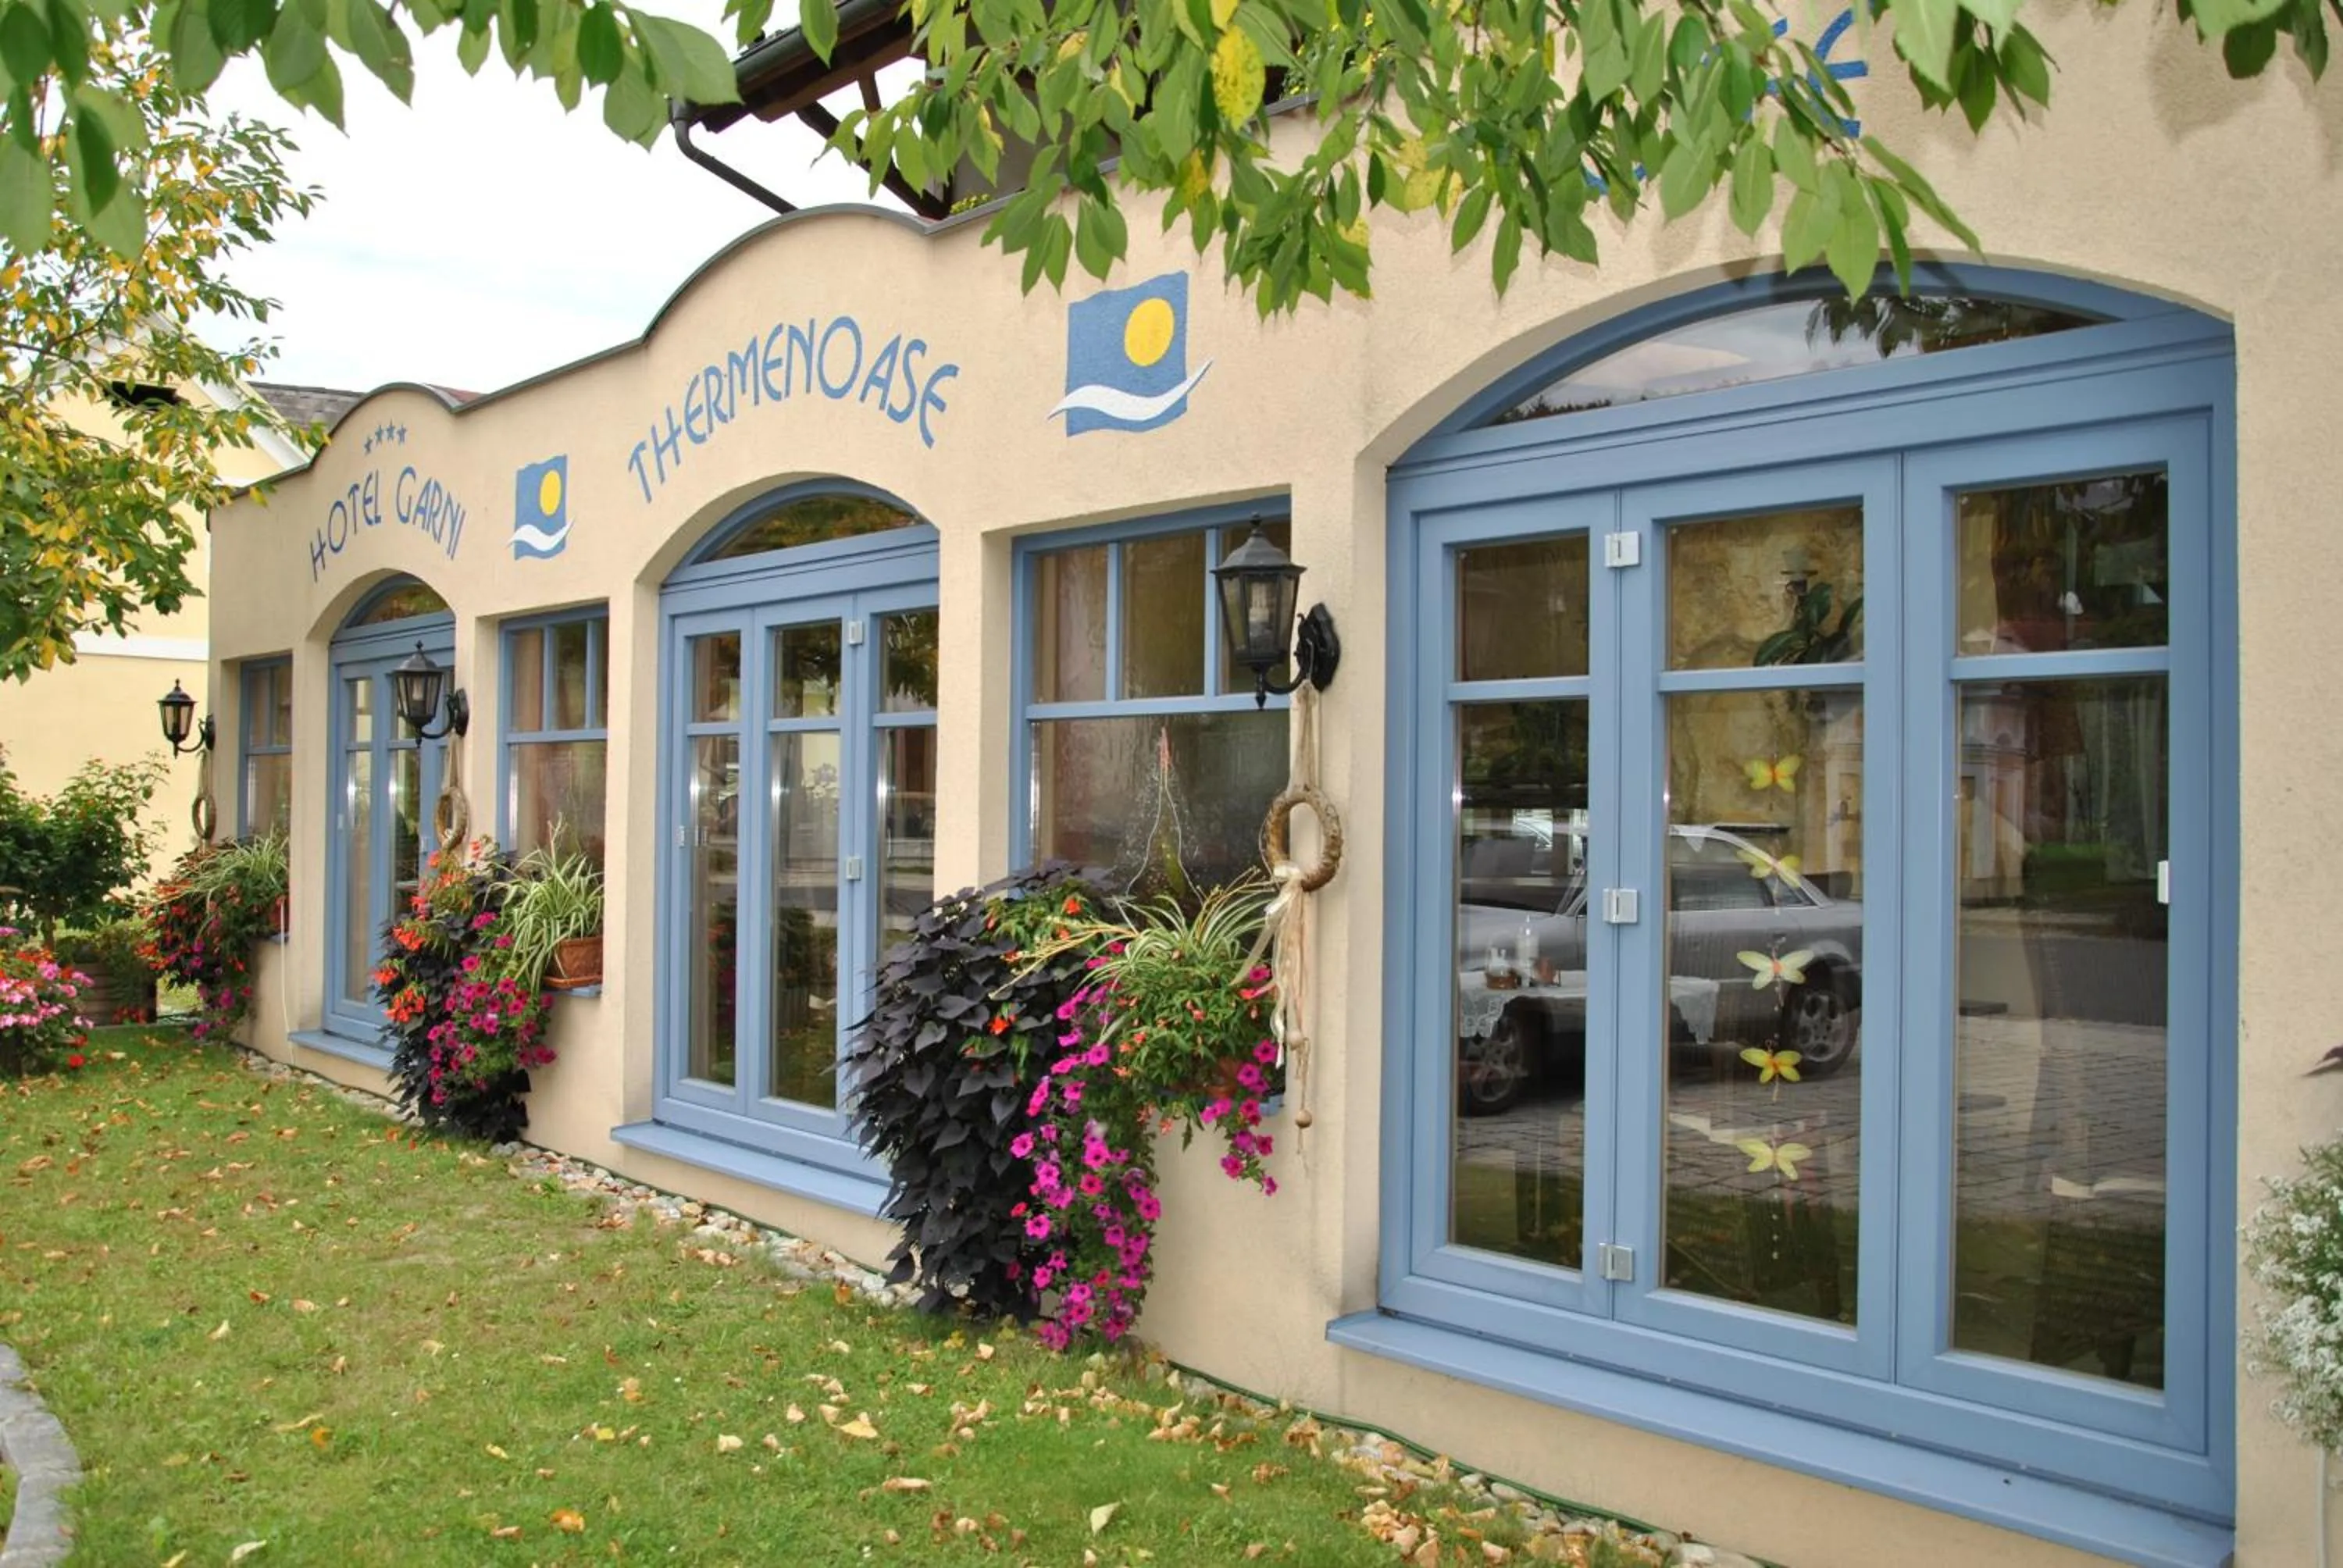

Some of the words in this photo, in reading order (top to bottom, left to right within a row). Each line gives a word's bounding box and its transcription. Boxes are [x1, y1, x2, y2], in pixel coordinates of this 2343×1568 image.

[628, 315, 960, 504] THERMENOASE
[310, 469, 382, 583] HOTEL
[396, 466, 466, 561] GARNI
